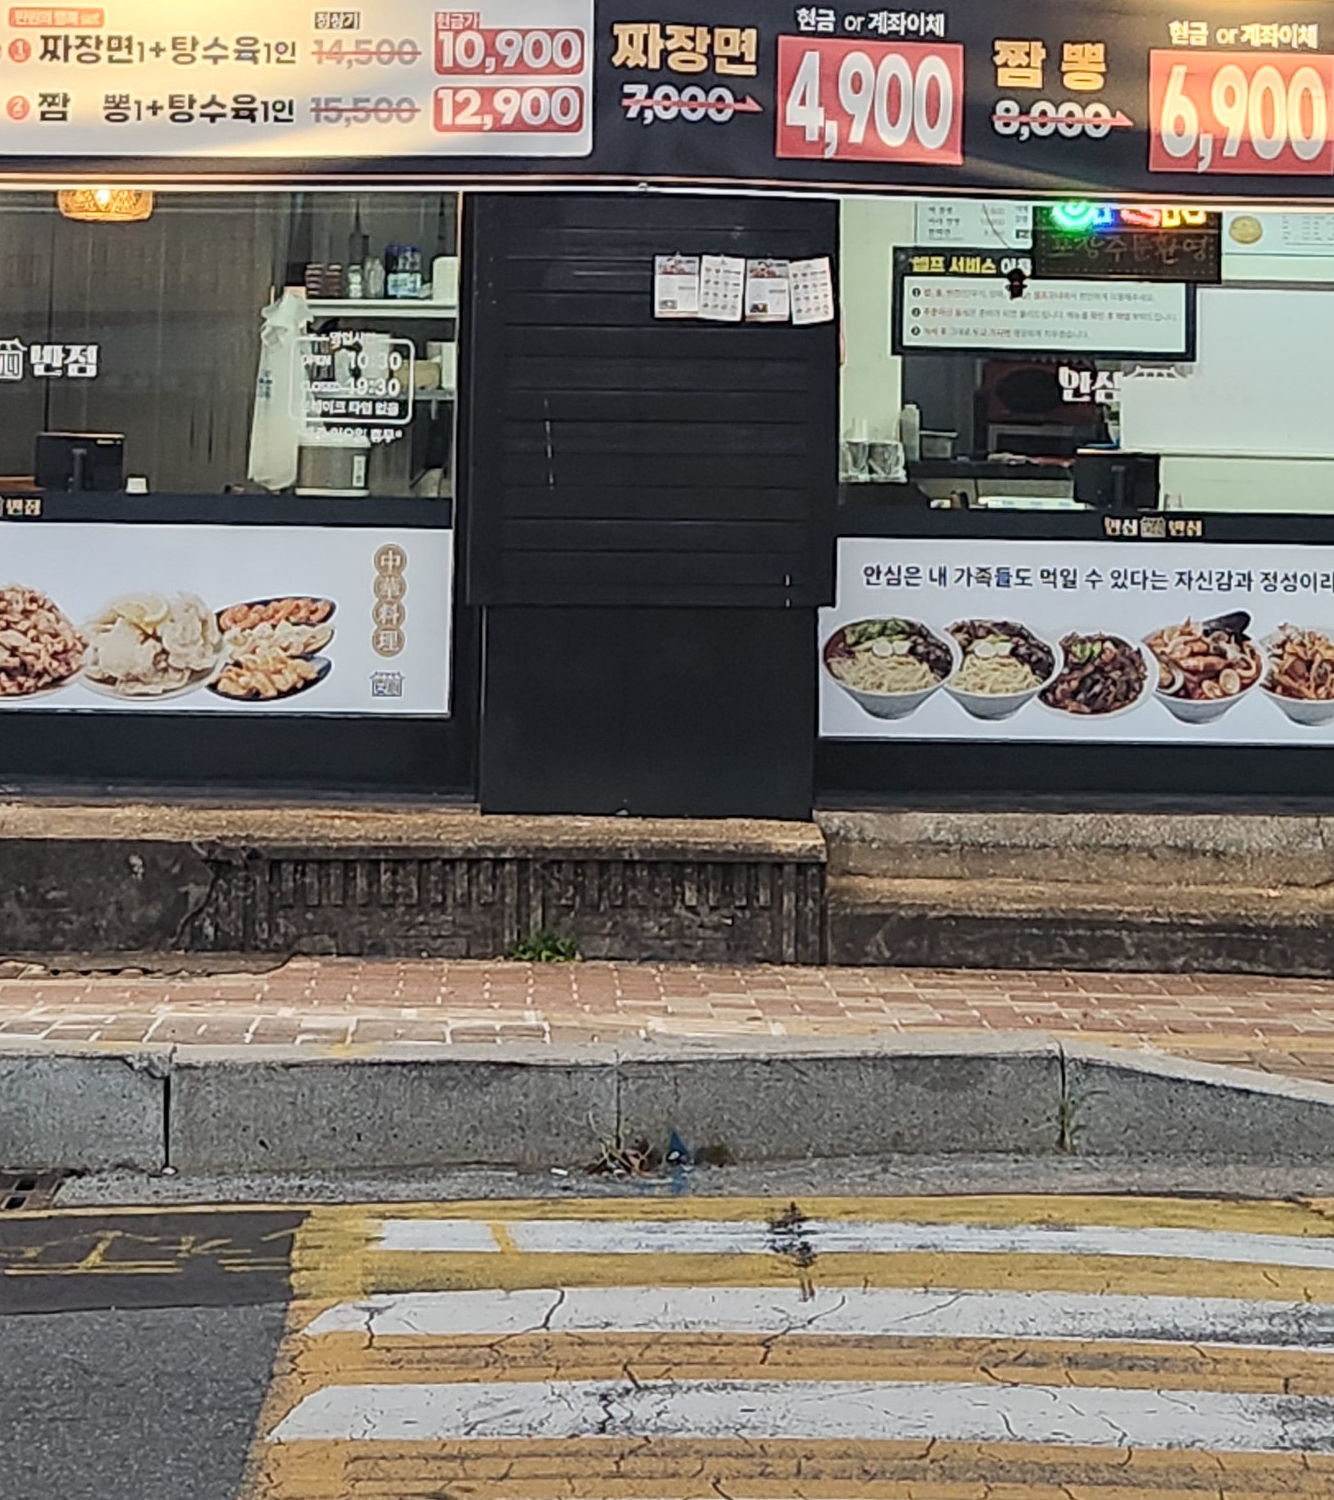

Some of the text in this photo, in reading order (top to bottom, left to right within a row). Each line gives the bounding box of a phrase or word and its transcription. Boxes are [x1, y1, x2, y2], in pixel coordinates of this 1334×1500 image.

[436, 12, 480, 30] 현금가
[797, 7, 947, 38] 현금 or 계좌이체
[1168, 20, 1319, 50] 현금 or 계좌이체
[313, 38, 418, 69] 14,500
[438, 30, 583, 74] 10,900
[612, 21, 759, 77] 짜장면
[994, 39, 1107, 92] 짬 뽕
[38, 92, 71, 122] 짬
[311, 96, 417, 128] 15,500
[437, 88, 581, 131] 12,900
[622, 84, 736, 125] 7,000
[785, 50, 953, 160] 4,900
[993, 100, 1112, 141] 8,000
[1160, 63, 1328, 173] 6,900
[948, 256, 998, 274] 서비스
[30, 343, 99, 378] 반점
[347, 377, 402, 397] 19:30
[1058, 366, 1123, 404] 안심
[863, 564, 923, 588] 안심은
[928, 565, 948, 588] 내
[953, 566, 1034, 589] 가족들도
[1040, 566, 1079, 590] 먹일
[1083, 568, 1105, 590] 수
[1110, 568, 1169, 591] 있다는
[1174, 569, 1254, 593] 자신감과
